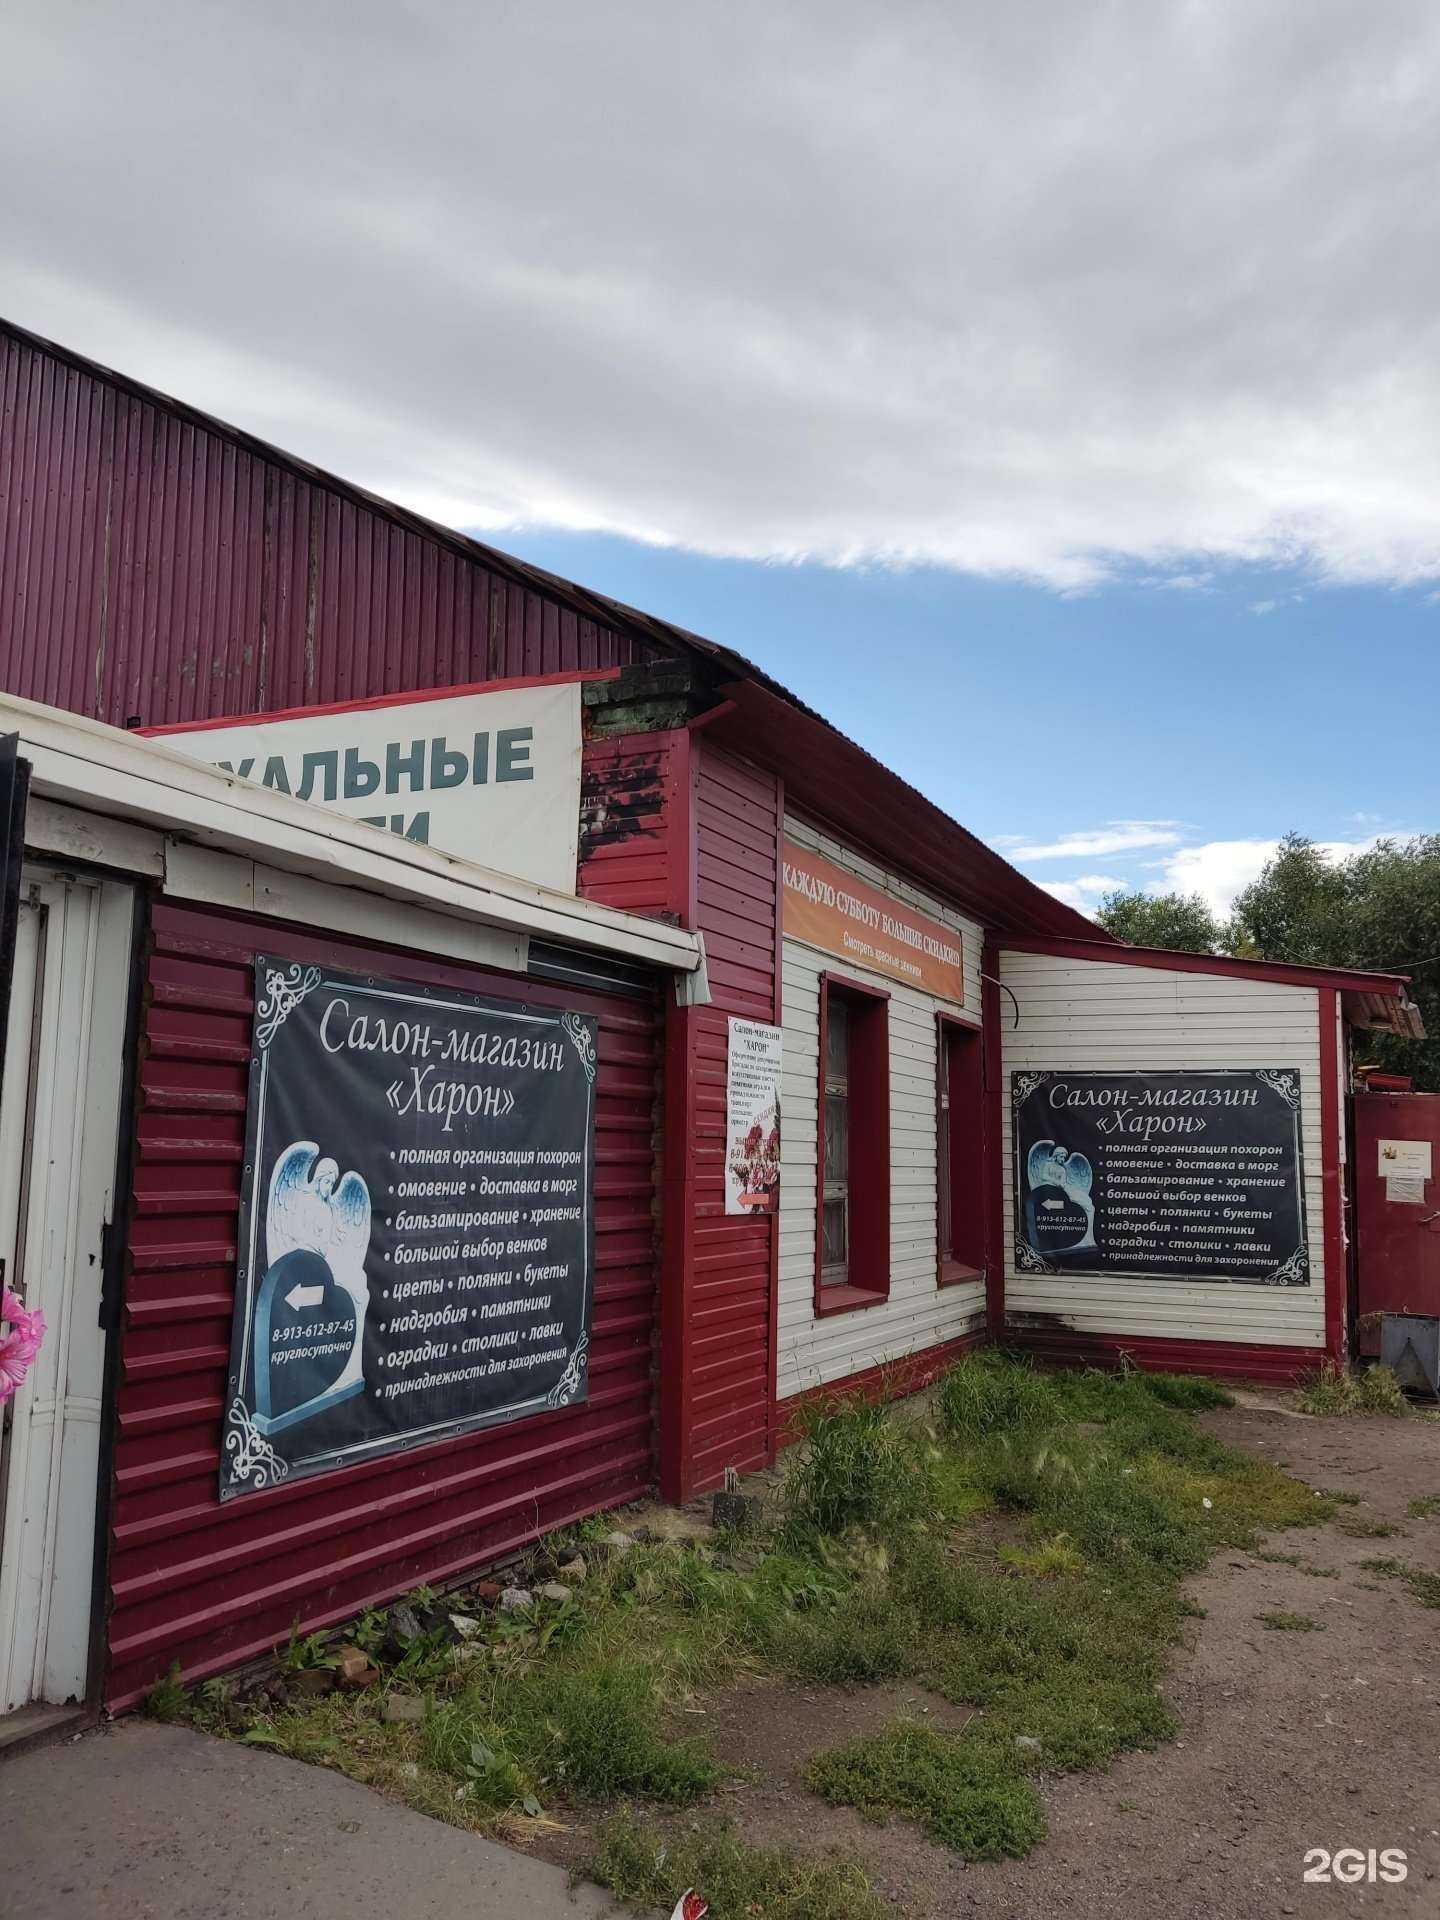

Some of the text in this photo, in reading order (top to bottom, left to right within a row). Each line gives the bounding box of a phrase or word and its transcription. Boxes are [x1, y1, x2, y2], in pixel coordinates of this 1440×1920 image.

[837, 891, 880, 930] СУББОТУ
[881, 914, 922, 950] БОЛЬШИЕ
[843, 931, 874, 957] Смотреть
[320, 999, 564, 1072] Салон-магазин
[386, 1064, 515, 1131] «Харон»
[1049, 1084, 1260, 1109] Салон-магазин
[1096, 1108, 1207, 1141] «Харон»
[399, 1149, 581, 1168] полная организация похорон
[1105, 1143, 1283, 1156] полная организация похорон
[1106, 1159, 1279, 1173] омовение доставка в морг
[398, 1176, 577, 1197] омовение доставка в морг
[1107, 1173, 1286, 1187] бальзамирование хранение
[1107, 1189, 1246, 1203] большой выбор венков
[395, 1206, 581, 1231] бальзамирование хранение
[1107, 1207, 1272, 1220] цветы полянки букеты
[1108, 1221, 1255, 1235] надгробия памятники
[394, 1237, 547, 1264] большой выбор венков
[1108, 1237, 1271, 1252] оградки столики лавки
[1109, 1251, 1279, 1266] принадлежности для захоронения
[393, 1264, 569, 1302] цветы полянки букеты
[390, 1295, 551, 1333] надгробия памятники
[272, 1319, 355, 1342] 8-913-612-87-45
[271, 1341, 352, 1366] круглосуточно
[387, 1322, 563, 1369] оградки столики лавки
[385, 1346, 567, 1400] принадлежности для захоронения
